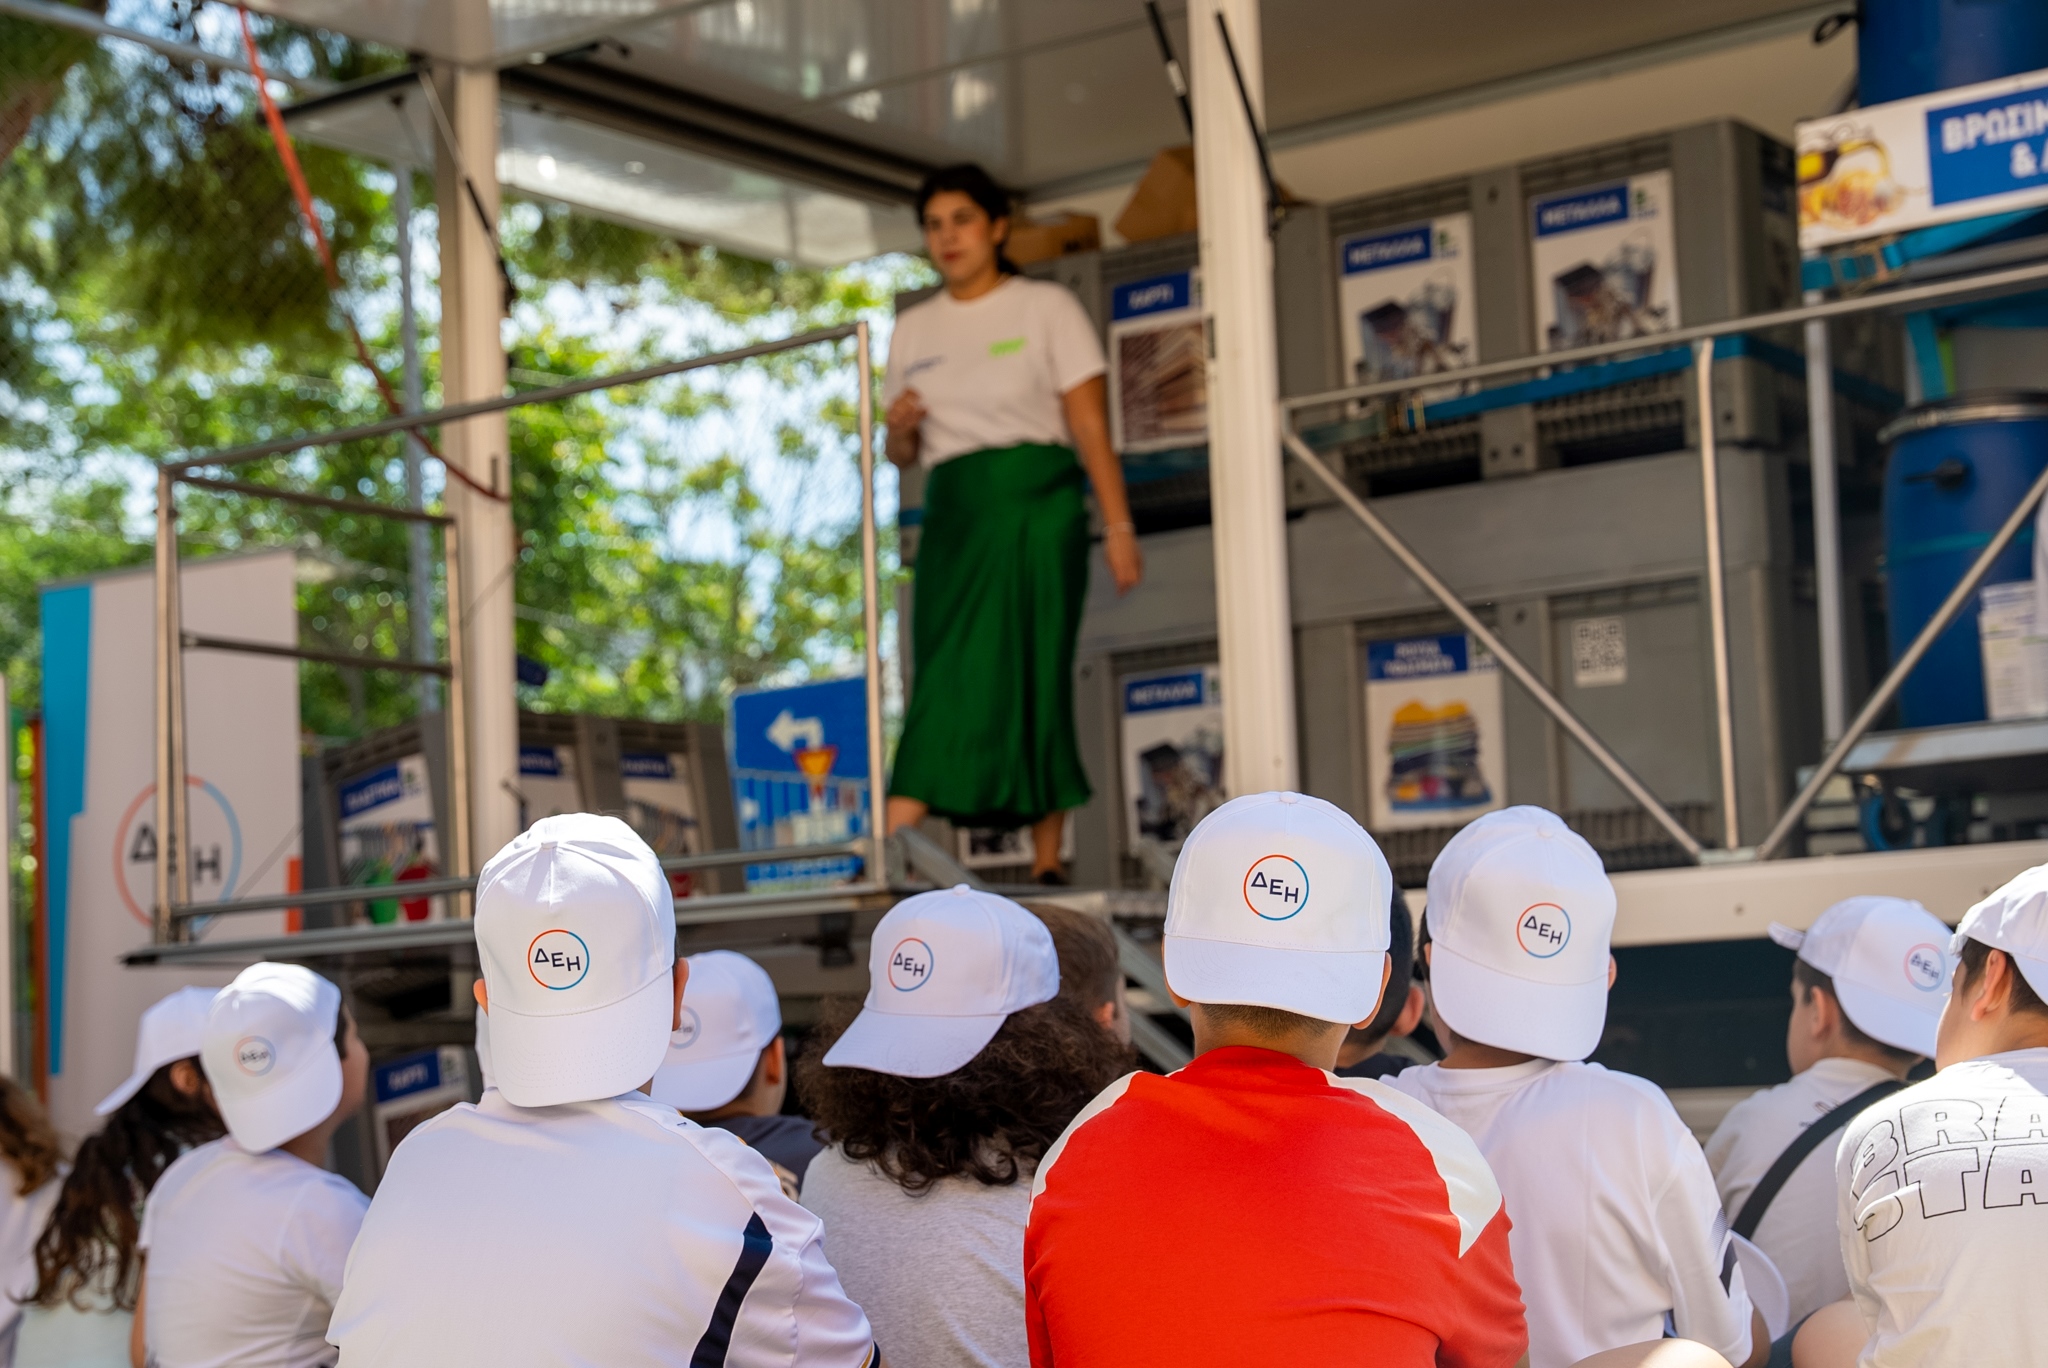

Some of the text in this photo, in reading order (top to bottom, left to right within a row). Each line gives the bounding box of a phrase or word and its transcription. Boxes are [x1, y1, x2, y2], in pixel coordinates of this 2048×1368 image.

[130, 822, 221, 884] ΔΗ
[1250, 871, 1299, 904] ΔΕΗ
[1523, 915, 1563, 945] ΔΕΗ
[534, 947, 581, 972] ΔΕΗ
[893, 952, 925, 977] ΔΕΗ
